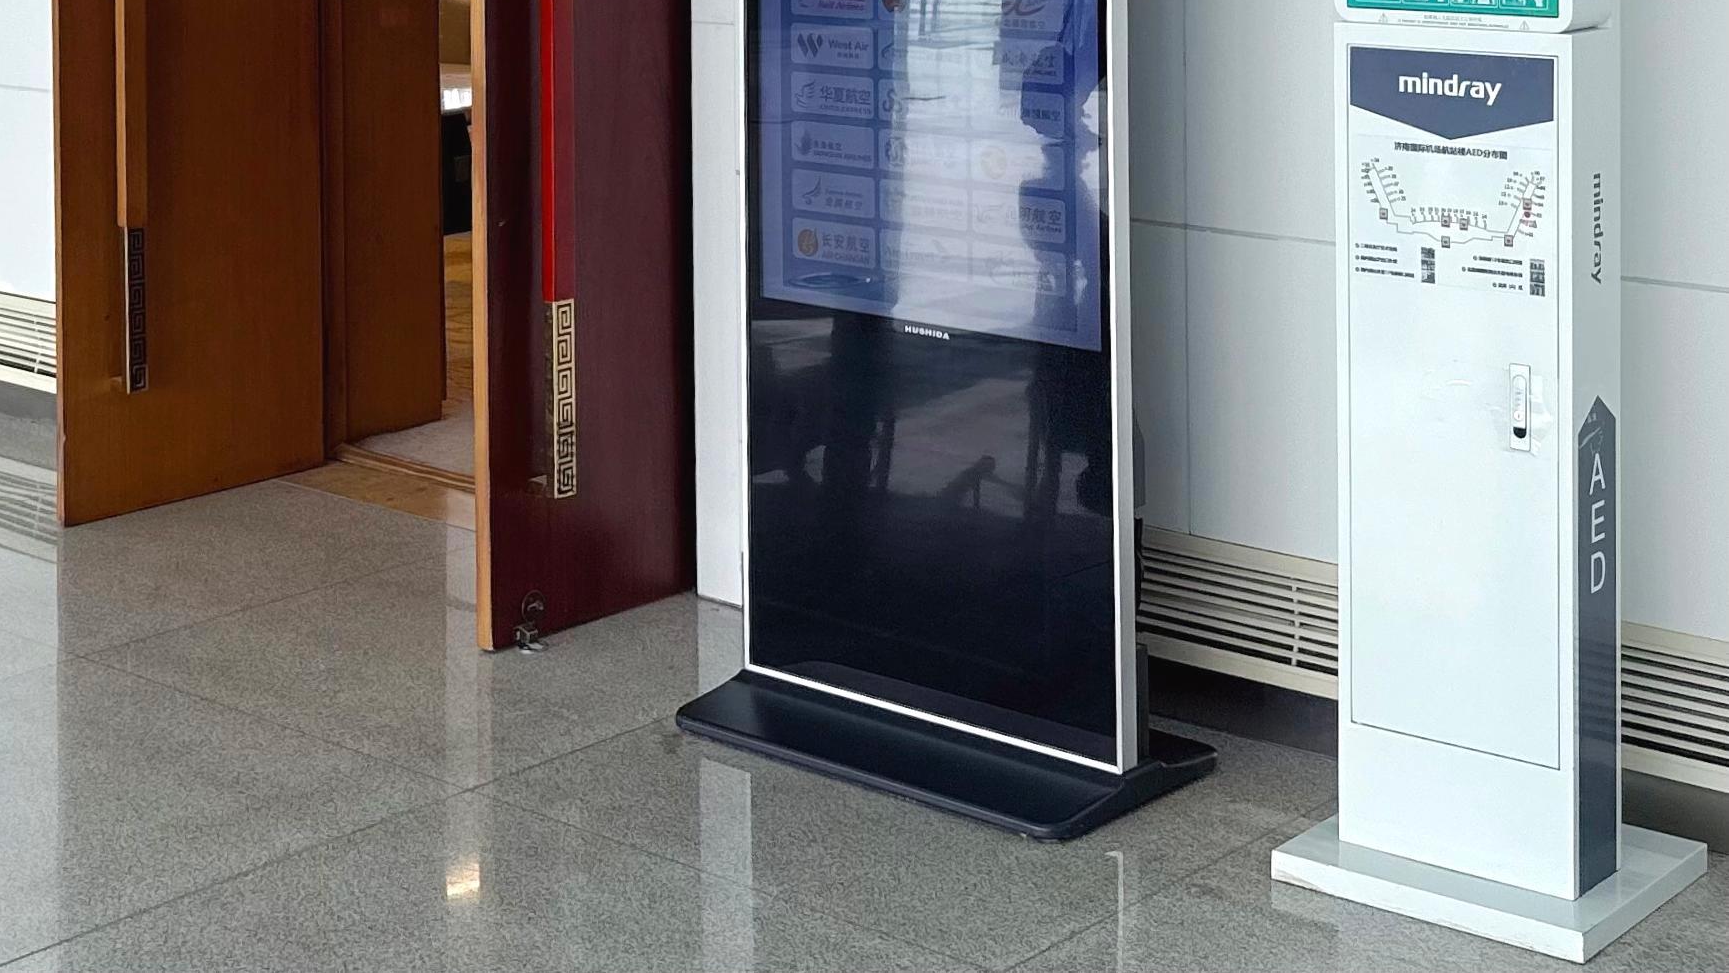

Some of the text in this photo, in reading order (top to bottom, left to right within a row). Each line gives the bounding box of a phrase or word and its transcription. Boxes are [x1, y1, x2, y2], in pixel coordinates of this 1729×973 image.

[1398, 72, 1502, 106] mindray
[1590, 173, 1604, 284] mindray
[904, 324, 950, 340] HUSHIDA
[1589, 452, 1606, 594] AED
